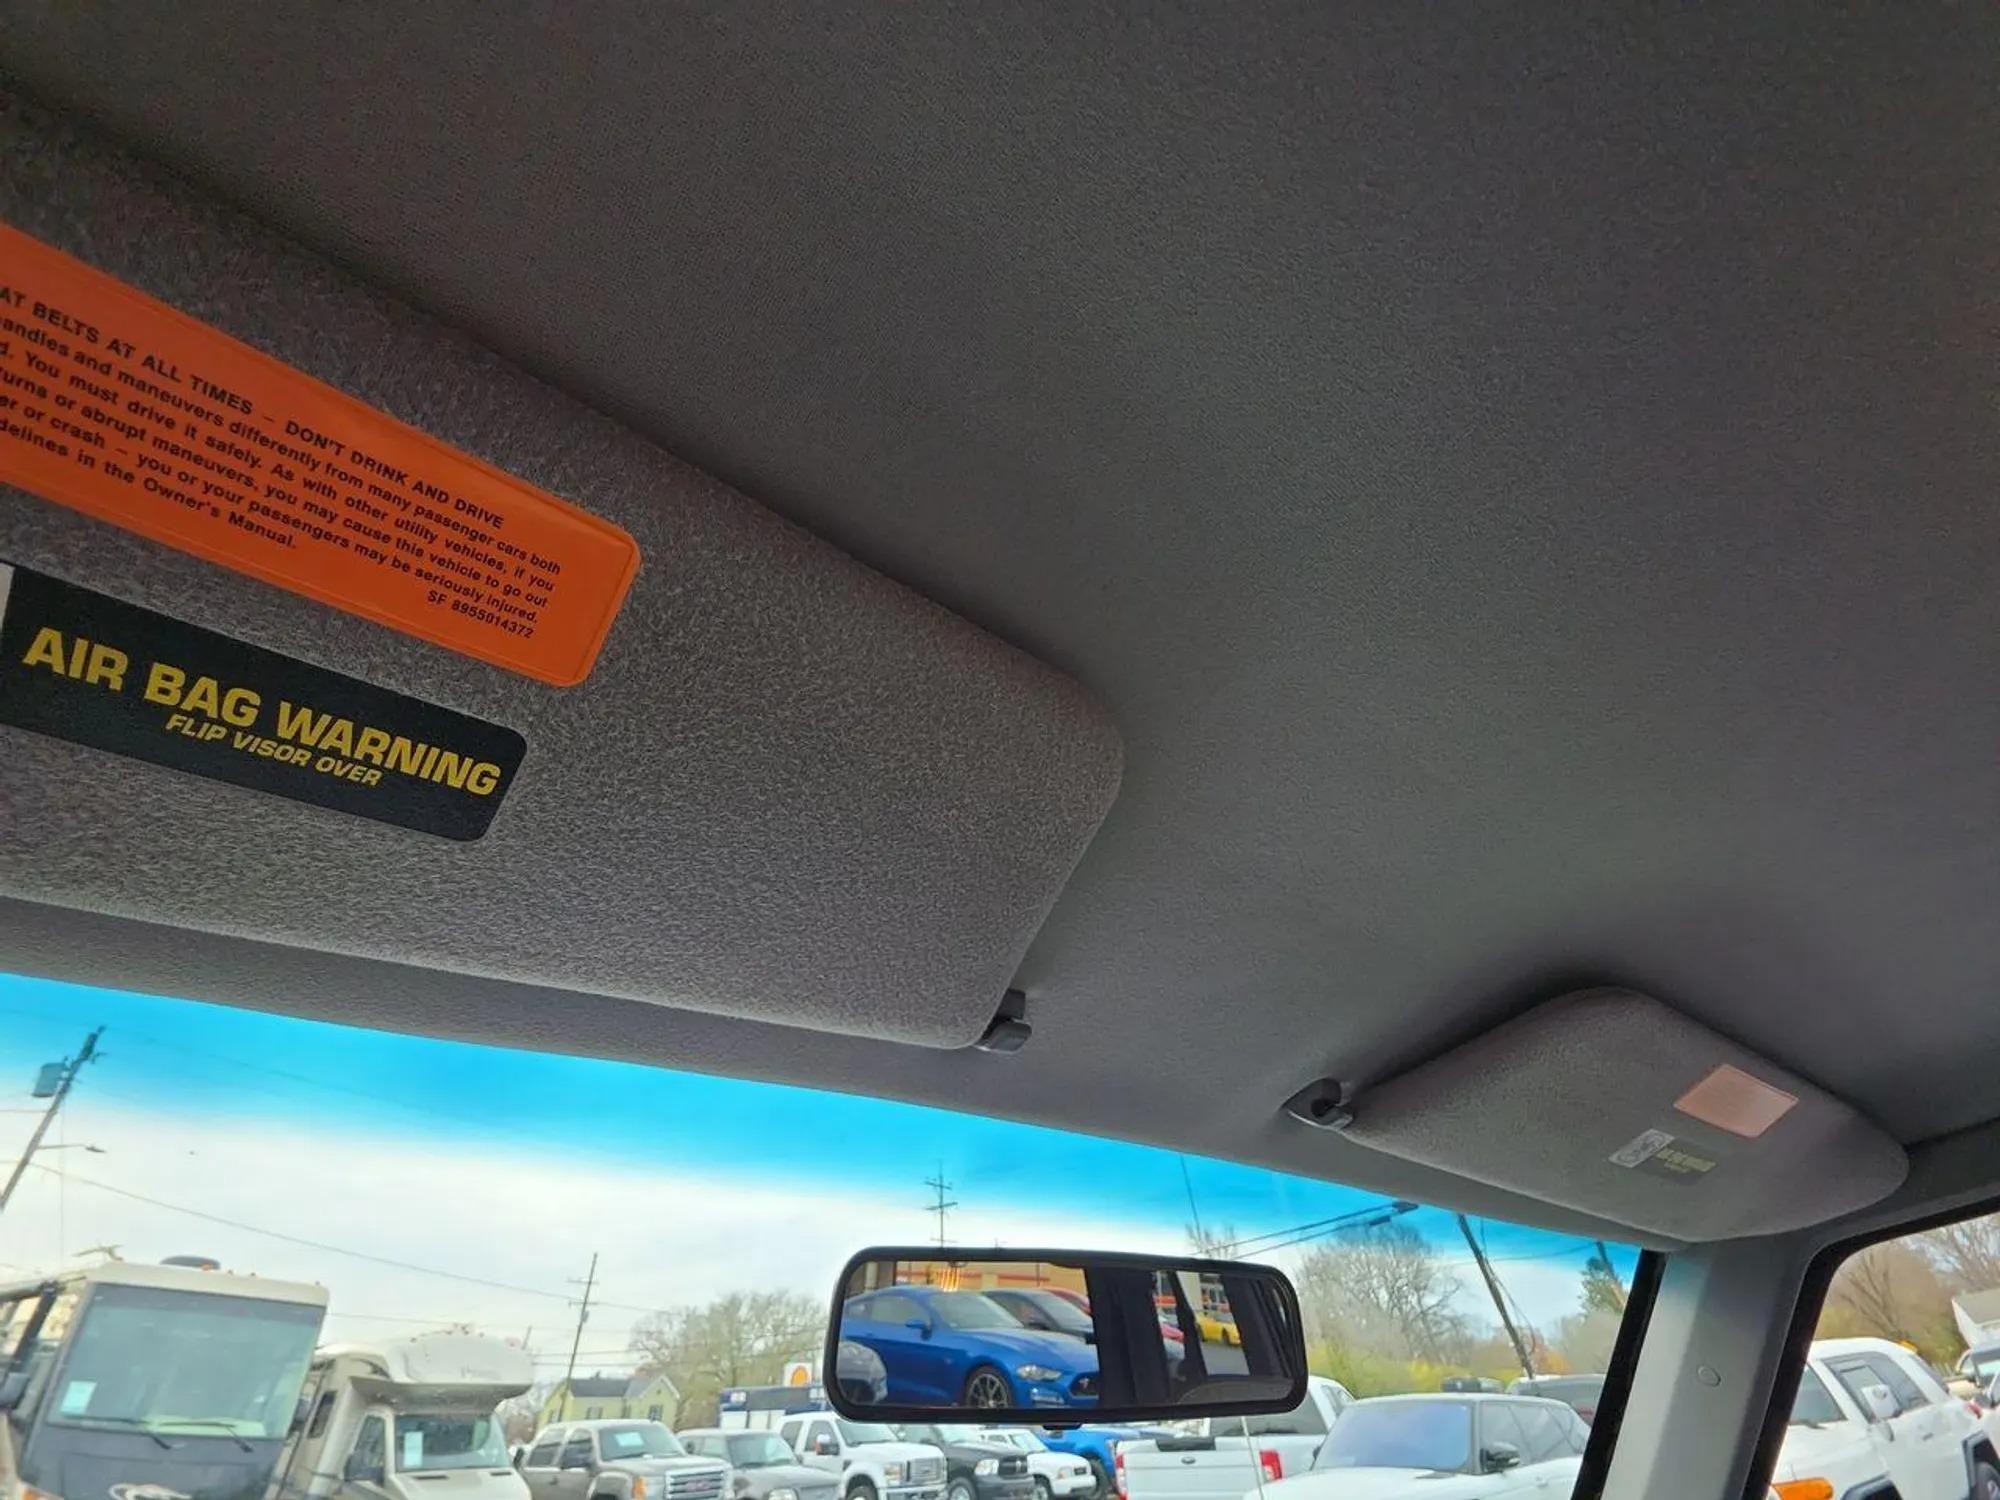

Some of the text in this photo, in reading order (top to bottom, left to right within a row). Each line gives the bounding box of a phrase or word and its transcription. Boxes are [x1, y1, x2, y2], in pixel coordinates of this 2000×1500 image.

[0, 316, 561, 575] andles and maneuvers differently from many passenger cars both
[23, 406, 46, 421] or
[50, 418, 106, 449] crash
[137, 453, 172, 476] you
[177, 471, 199, 485] or
[202, 481, 245, 504] your
[247, 501, 350, 549] passengers
[354, 543, 388, 565] may
[390, 555, 411, 573] be
[415, 567, 484, 603] seriously
[486, 594, 538, 624] injured.
[25, 350, 60, 379] You
[69, 375, 119, 405] must
[127, 400, 176, 430] drive
[184, 423, 197, 440] it
[204, 436, 262, 469] safely.
[271, 463, 295, 481] As
[302, 478, 337, 501] with
[344, 496, 388, 521] other
[394, 517, 439, 544] utility
[444, 538, 507, 574] vehicles,
[513, 566, 526, 580] if
[527, 575, 556, 592] you
[32, 302, 99, 344] BELTS
[106, 338, 136, 358] AT
[141, 355, 182, 383] ALL
[190, 374, 253, 414] TIMES
[285, 420, 345, 456] DON'T
[350, 450, 408, 487] DRINK
[412, 480, 449, 503] AND
[454, 498, 504, 530] DRIVE
[54, 394, 77, 411] or
[80, 405, 147, 441] abrupt
[264, 484, 298, 506] you
[303, 501, 339, 524] may
[342, 518, 392, 544] cause
[395, 538, 425, 558] this
[429, 552, 482, 581] vehicle
[485, 574, 500, 588] to
[503, 583, 522, 597] go
[525, 592, 548, 608] out
[77, 448, 96, 468] in
[104, 461, 135, 484] the
[144, 477, 221, 519] Owner's
[228, 511, 297, 549] Manual.
[22, 627, 501, 796] AIR BAG WARNING
[427, 589, 535, 640] SF 8955014372
[165, 713, 383, 786] FLIP VISOR OVER
